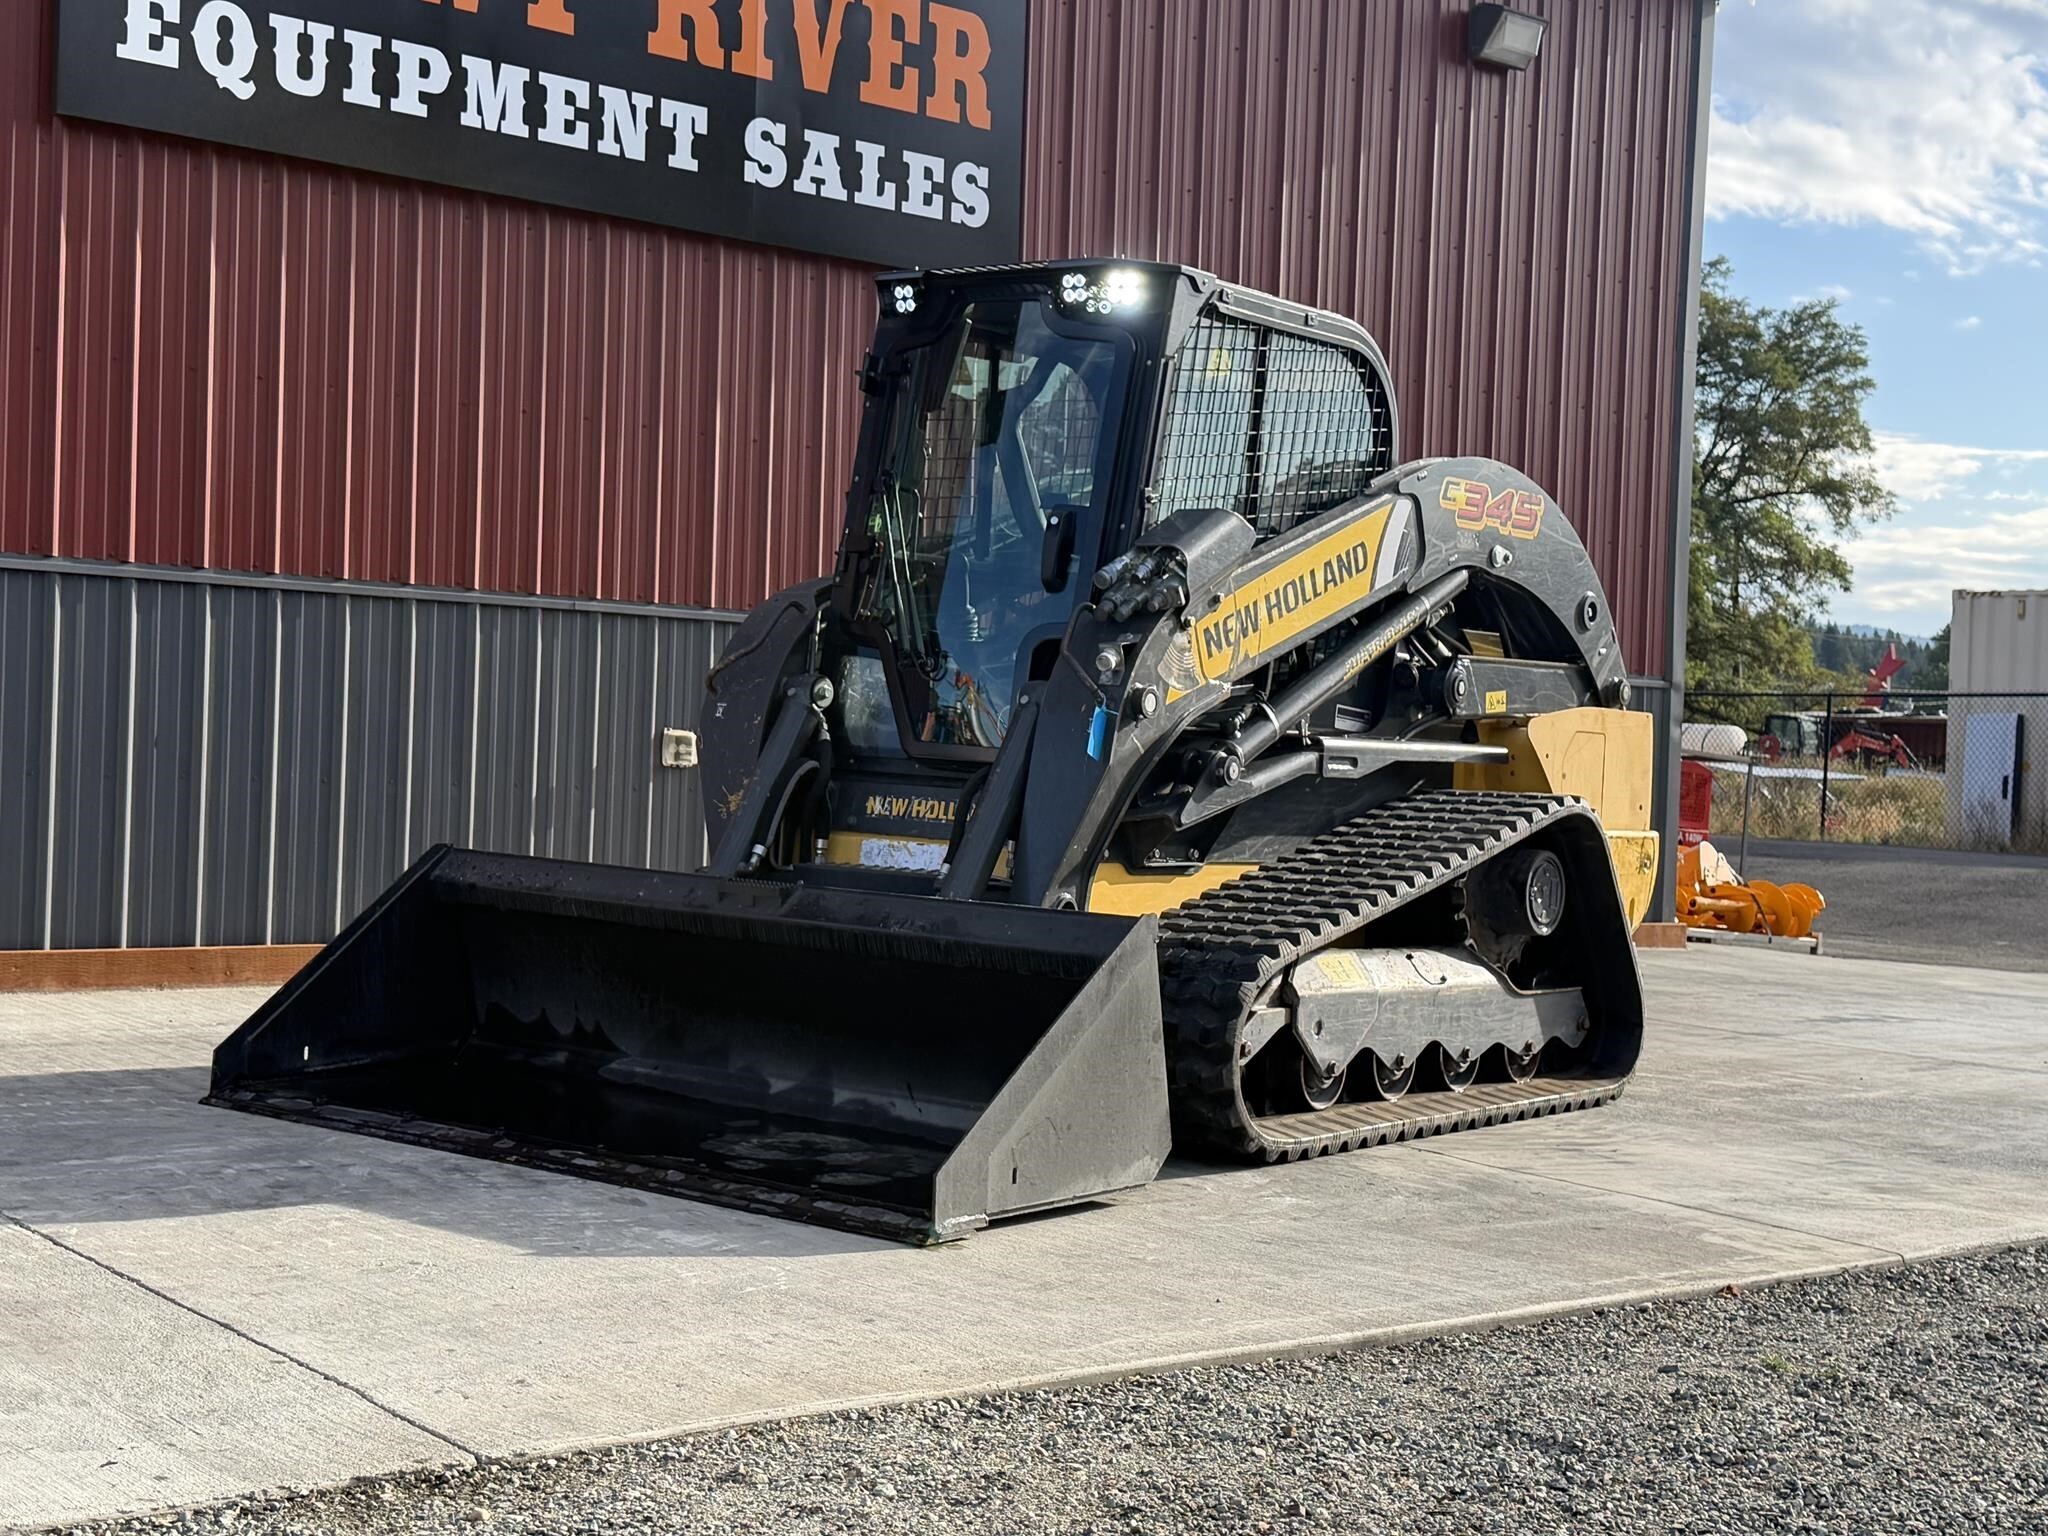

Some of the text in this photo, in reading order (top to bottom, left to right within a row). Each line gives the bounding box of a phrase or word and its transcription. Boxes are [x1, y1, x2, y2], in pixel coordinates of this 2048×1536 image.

[116, 0, 991, 228] EQUIPMENT SALES
[1440, 476, 1544, 540] C345
[1203, 600, 1260, 659] NEW
[1264, 541, 1368, 625] HOLLAND
[866, 796, 909, 817] NEW
